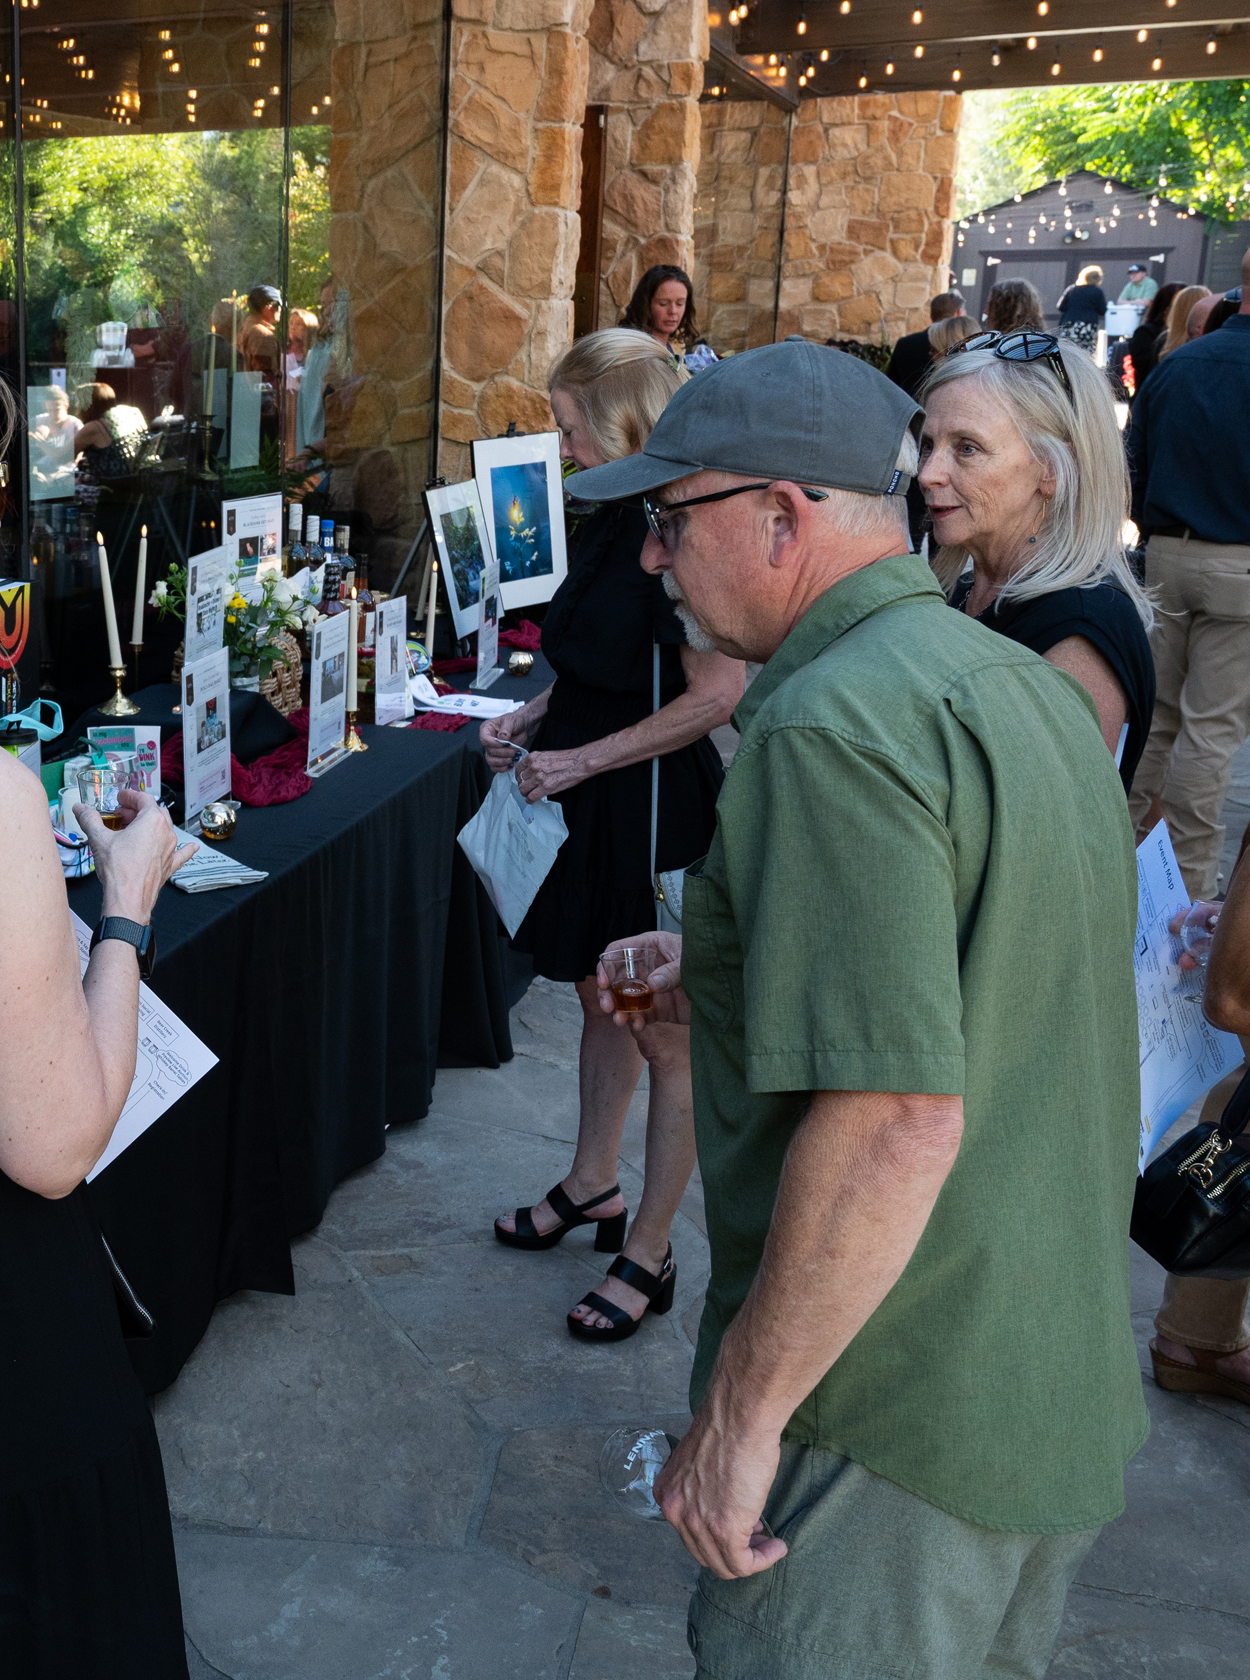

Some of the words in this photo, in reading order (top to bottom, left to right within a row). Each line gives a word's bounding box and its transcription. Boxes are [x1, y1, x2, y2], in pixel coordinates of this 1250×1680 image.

[888, 471, 900, 493] PONCHO
[138, 752, 155, 761] DINK
[1158, 839, 1169, 868] Event
[1165, 868, 1174, 890] Map
